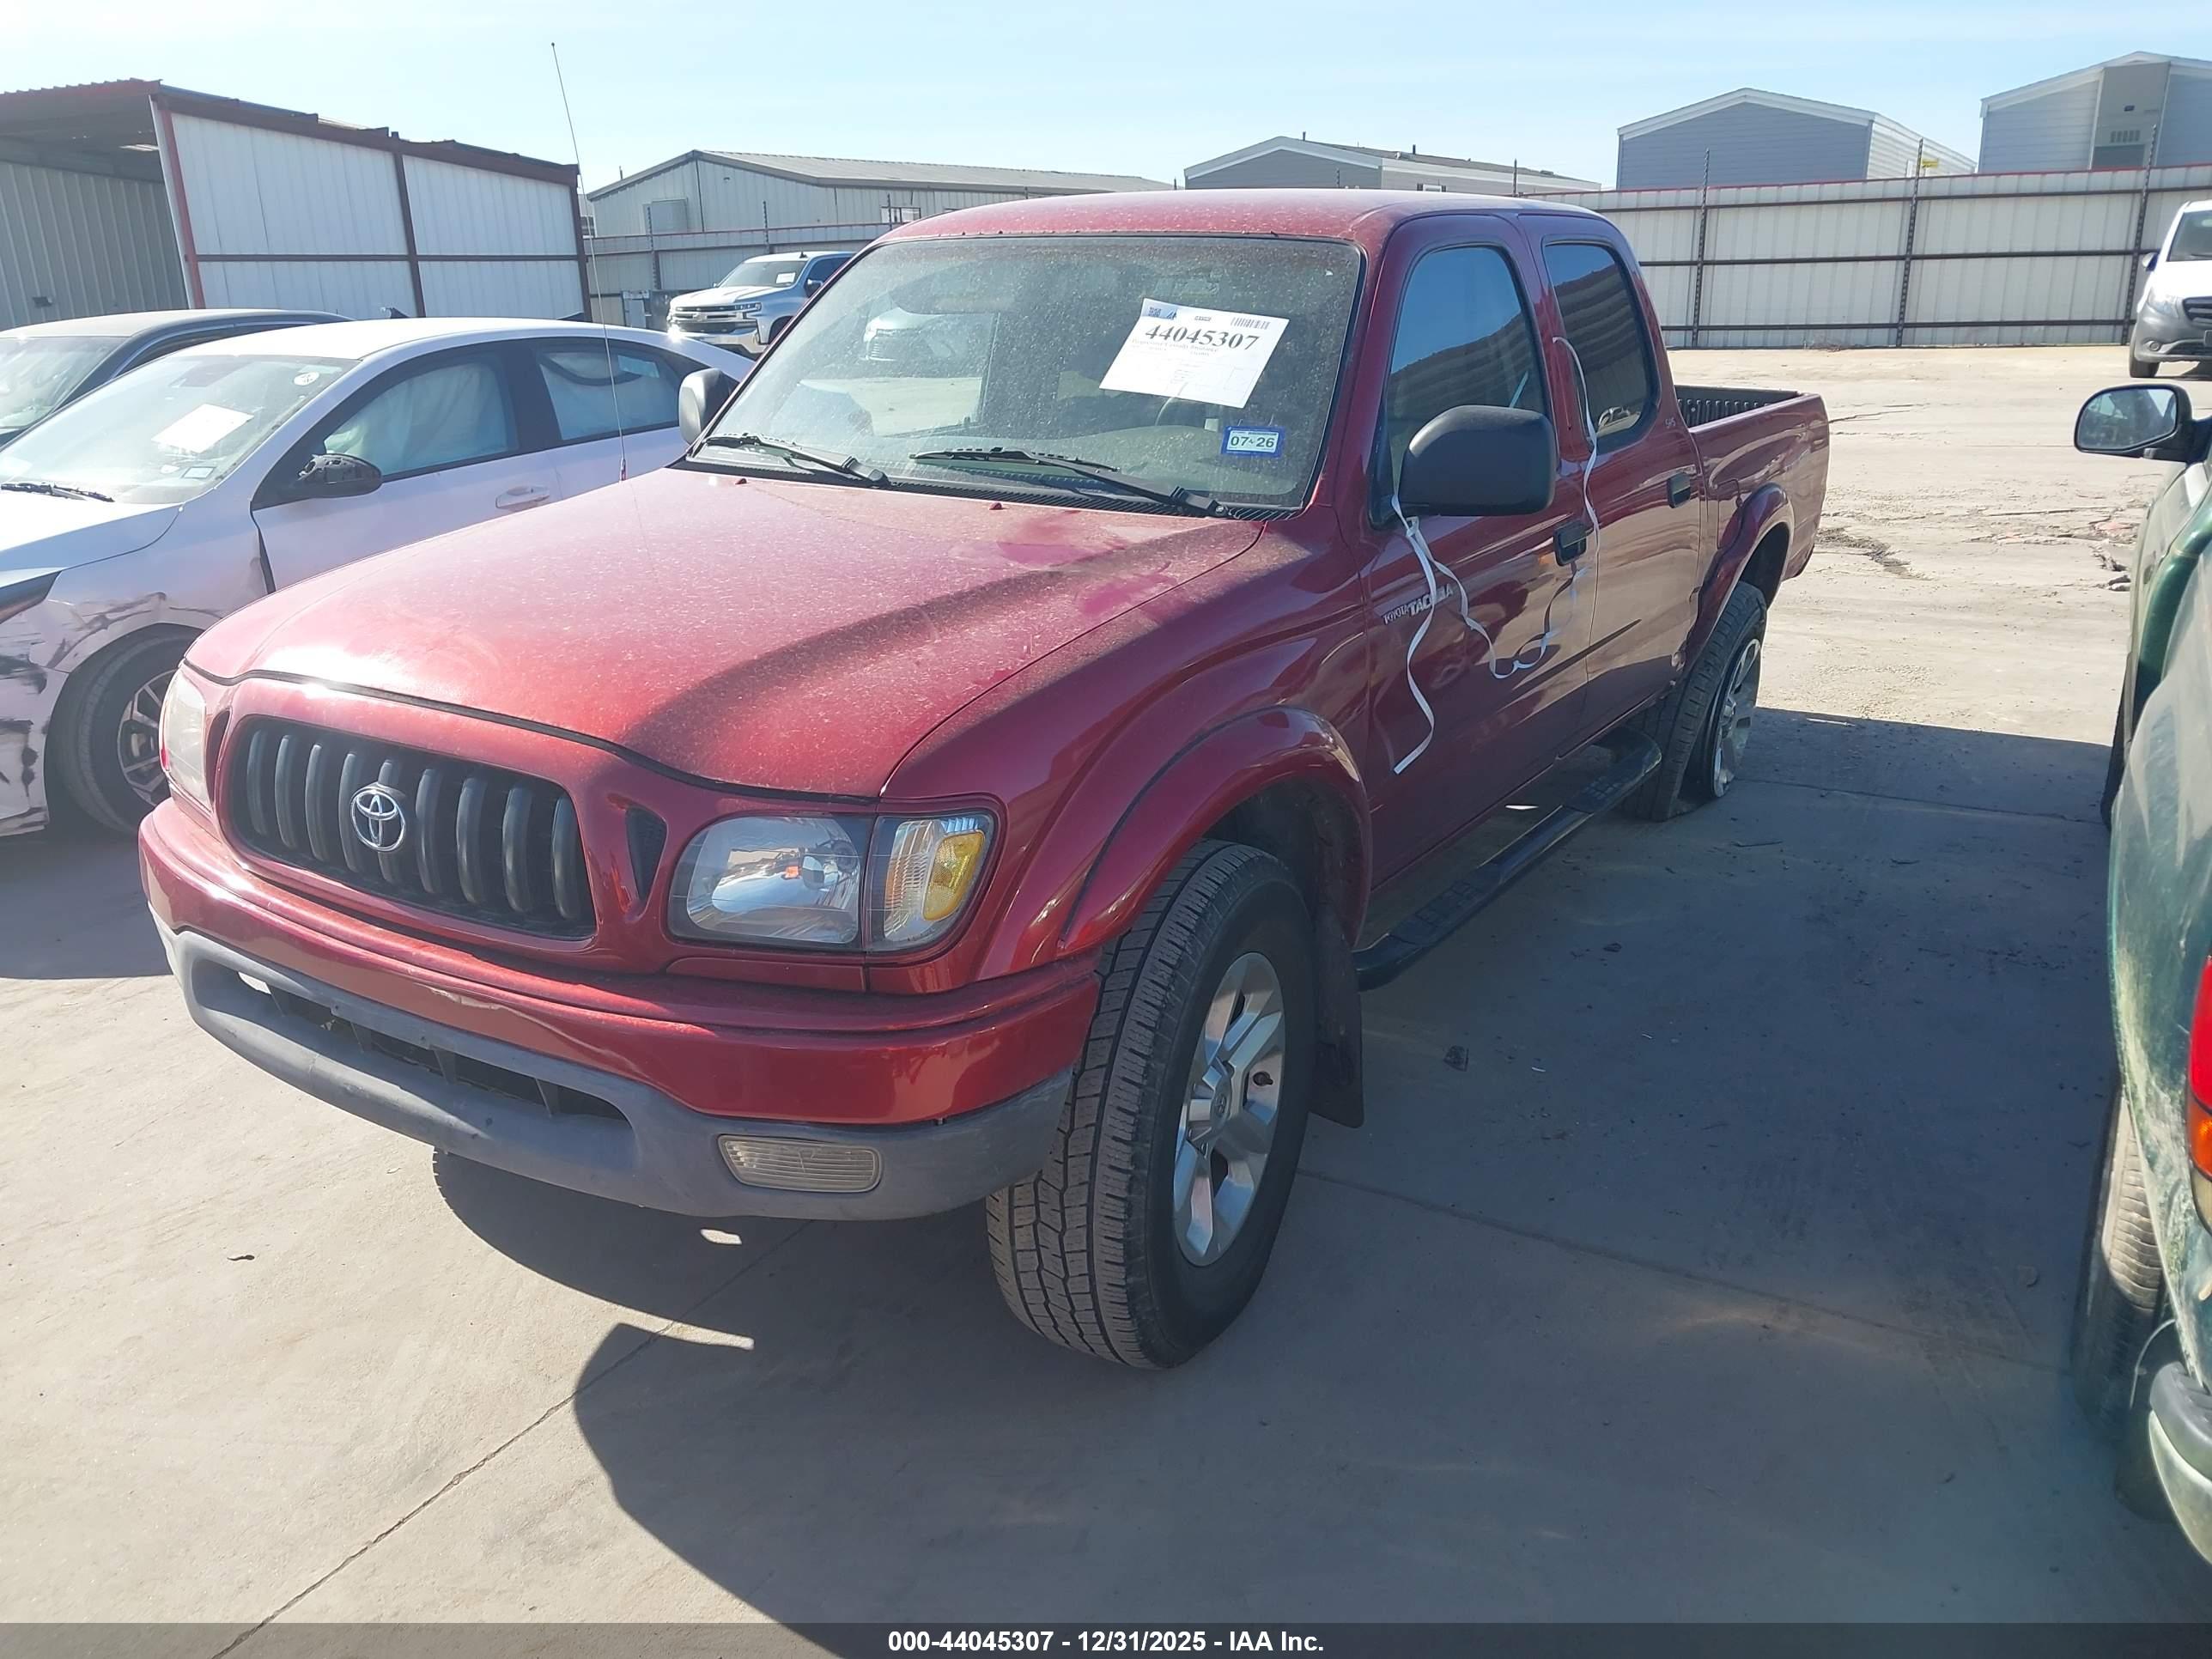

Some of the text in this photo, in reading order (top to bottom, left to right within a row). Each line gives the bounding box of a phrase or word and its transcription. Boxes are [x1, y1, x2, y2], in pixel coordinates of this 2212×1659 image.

[1145, 325, 1261, 350] 44045307
[1231, 435, 1275, 448] 07 26
[1382, 605, 1409, 624] TOYOTA
